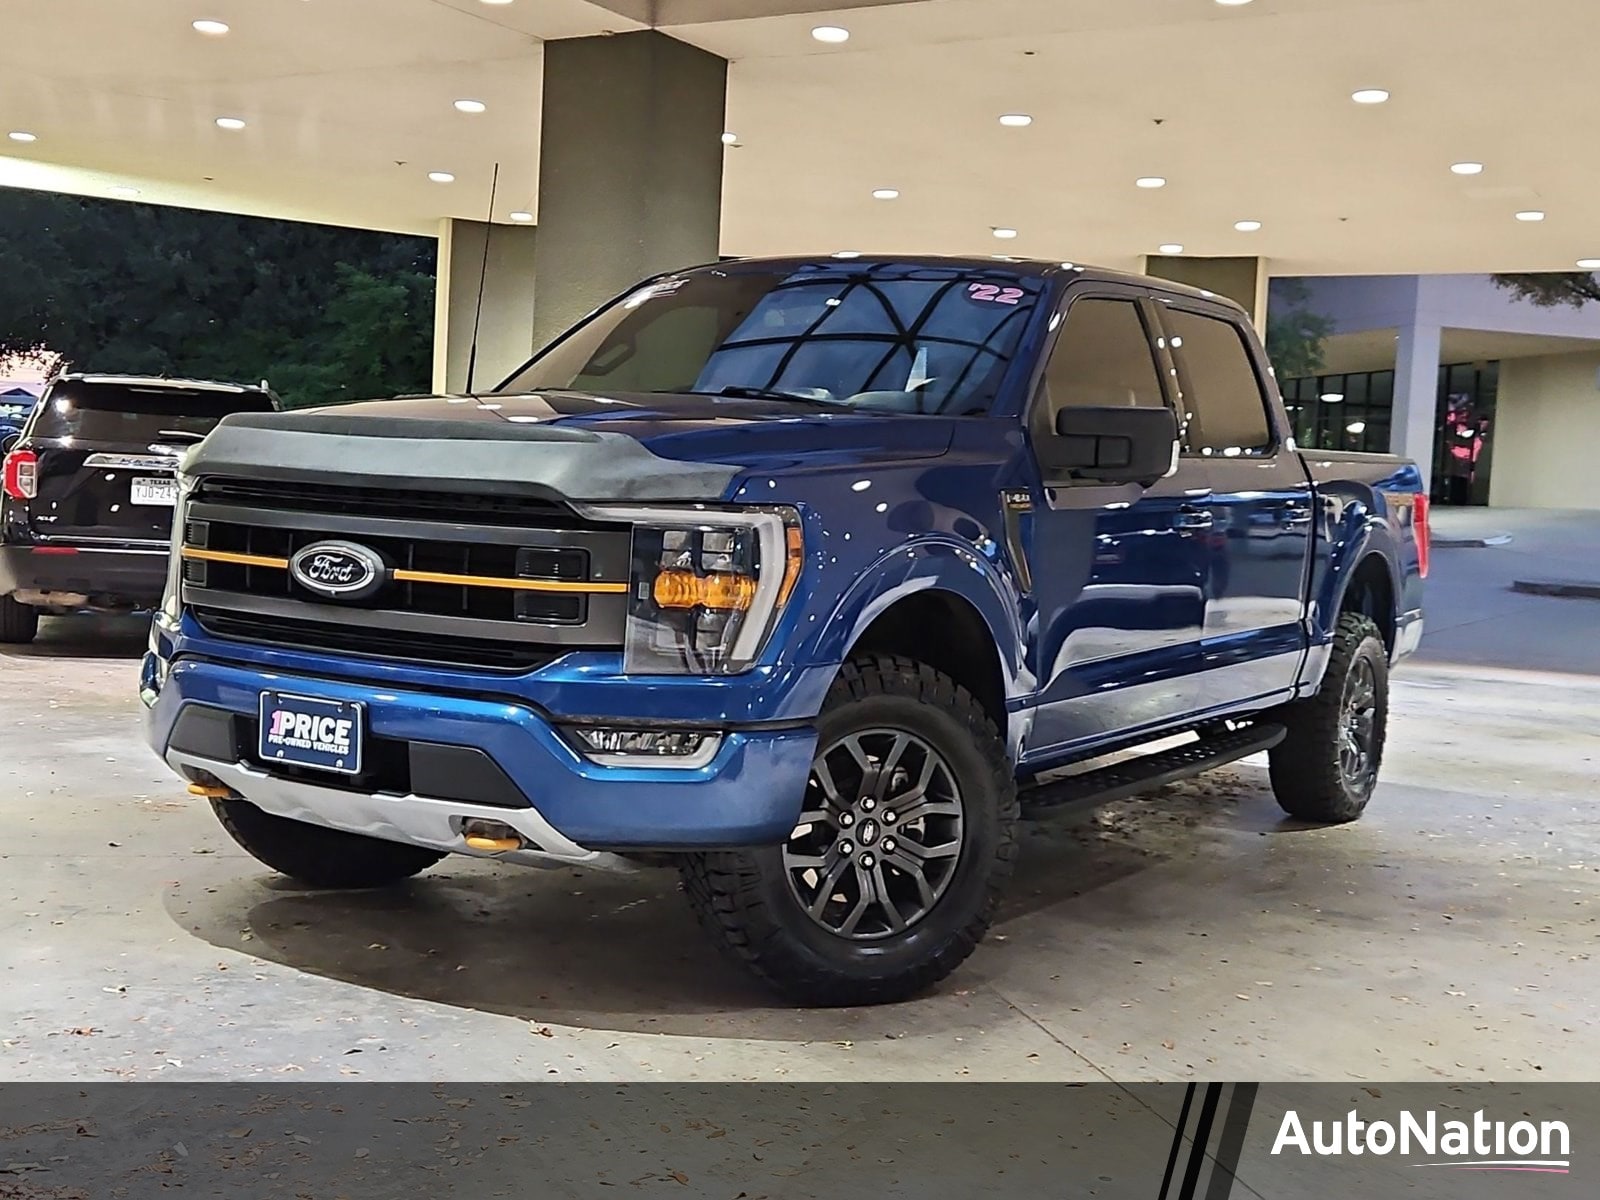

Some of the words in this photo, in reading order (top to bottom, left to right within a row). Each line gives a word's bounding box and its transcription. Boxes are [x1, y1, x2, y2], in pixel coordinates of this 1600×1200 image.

[967, 282, 1024, 305] '22
[308, 554, 354, 582] Ford
[269, 710, 353, 746] 1PRICE
[268, 733, 312, 749] PRE-OWNED
[312, 741, 350, 756] VEHICLES
